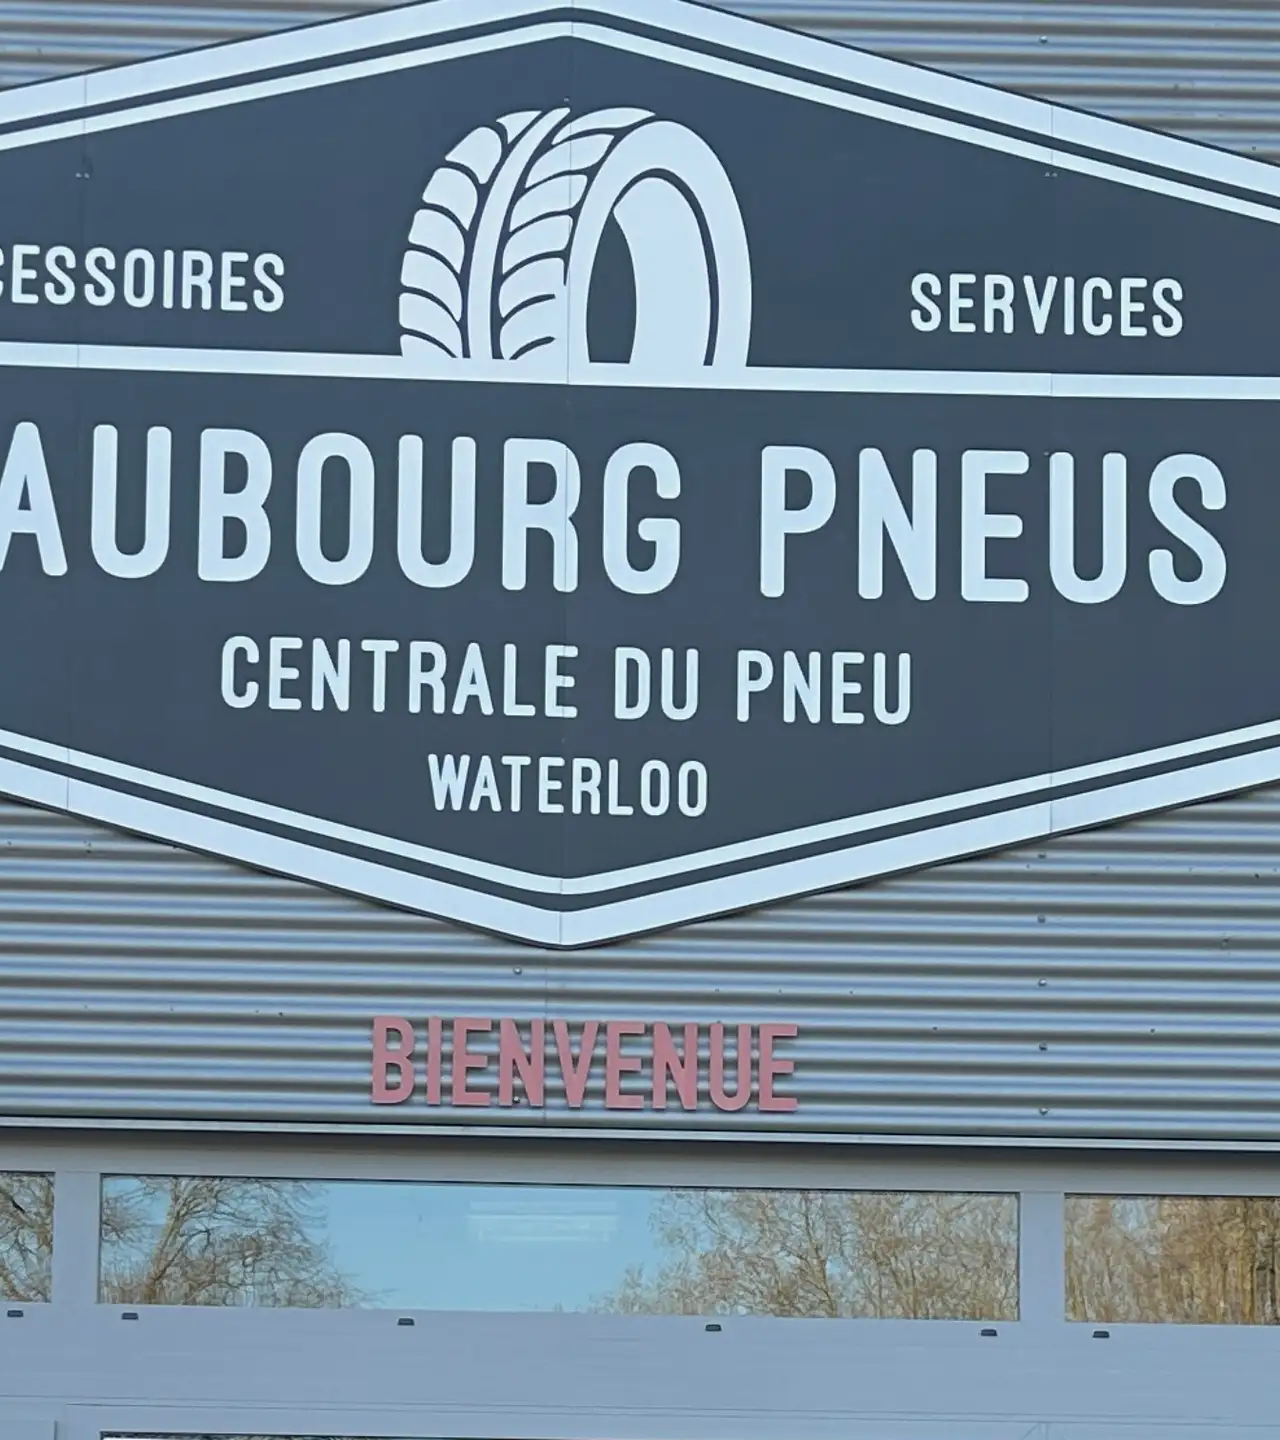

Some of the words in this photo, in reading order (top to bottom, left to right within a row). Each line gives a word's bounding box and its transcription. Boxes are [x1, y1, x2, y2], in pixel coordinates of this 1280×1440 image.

[910, 273, 1184, 338] SERVICES
[759, 445, 1227, 605] PNEUS
[220, 635, 579, 718] CENTRALE
[614, 646, 699, 721] DU
[736, 650, 911, 725] PNEU
[427, 754, 708, 817] WATERLOO
[371, 1016, 798, 1112] BIENVENUE
